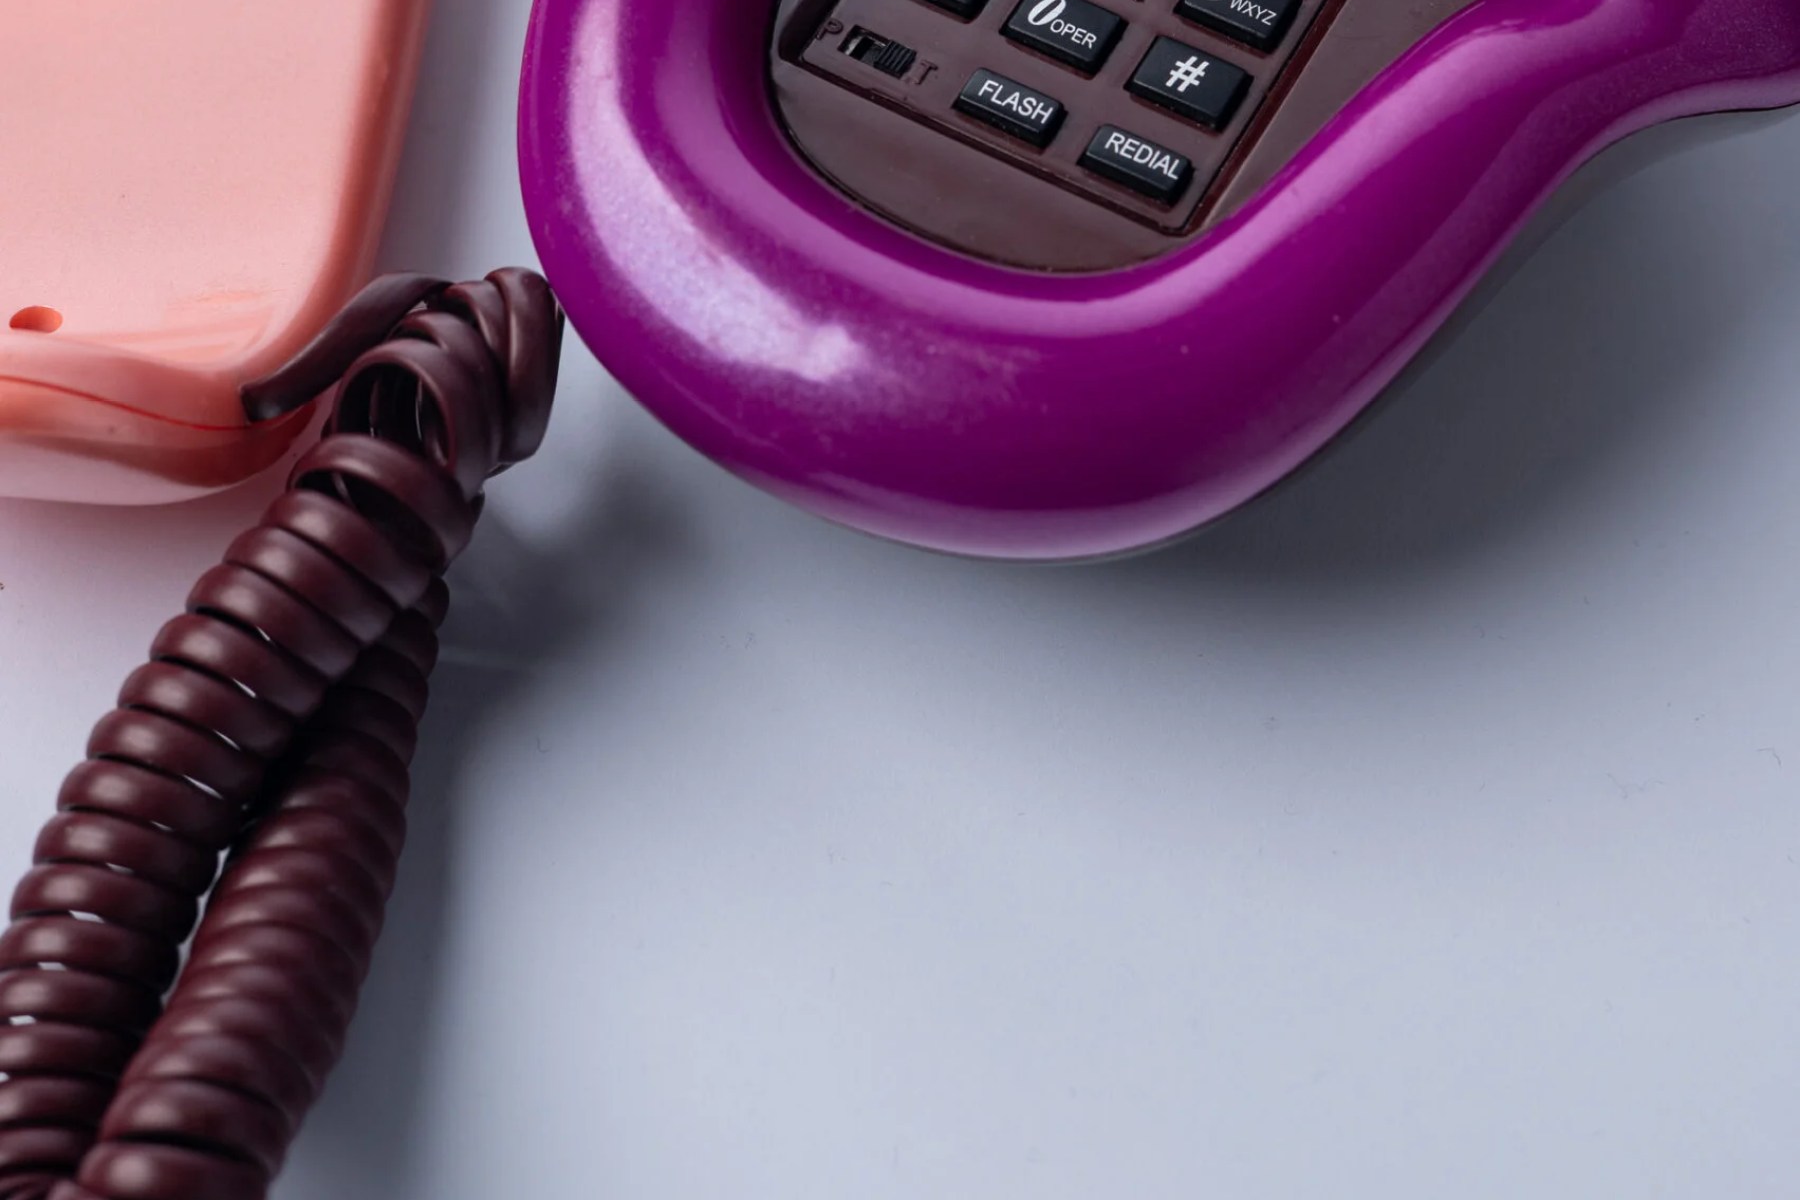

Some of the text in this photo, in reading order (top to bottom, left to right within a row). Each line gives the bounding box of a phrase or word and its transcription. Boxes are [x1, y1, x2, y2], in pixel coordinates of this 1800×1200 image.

[1049, 18, 1097, 49] OPER
[1165, 55, 1210, 93] #
[977, 79, 1054, 125] FLASH
[1104, 131, 1180, 180] REDIAL
